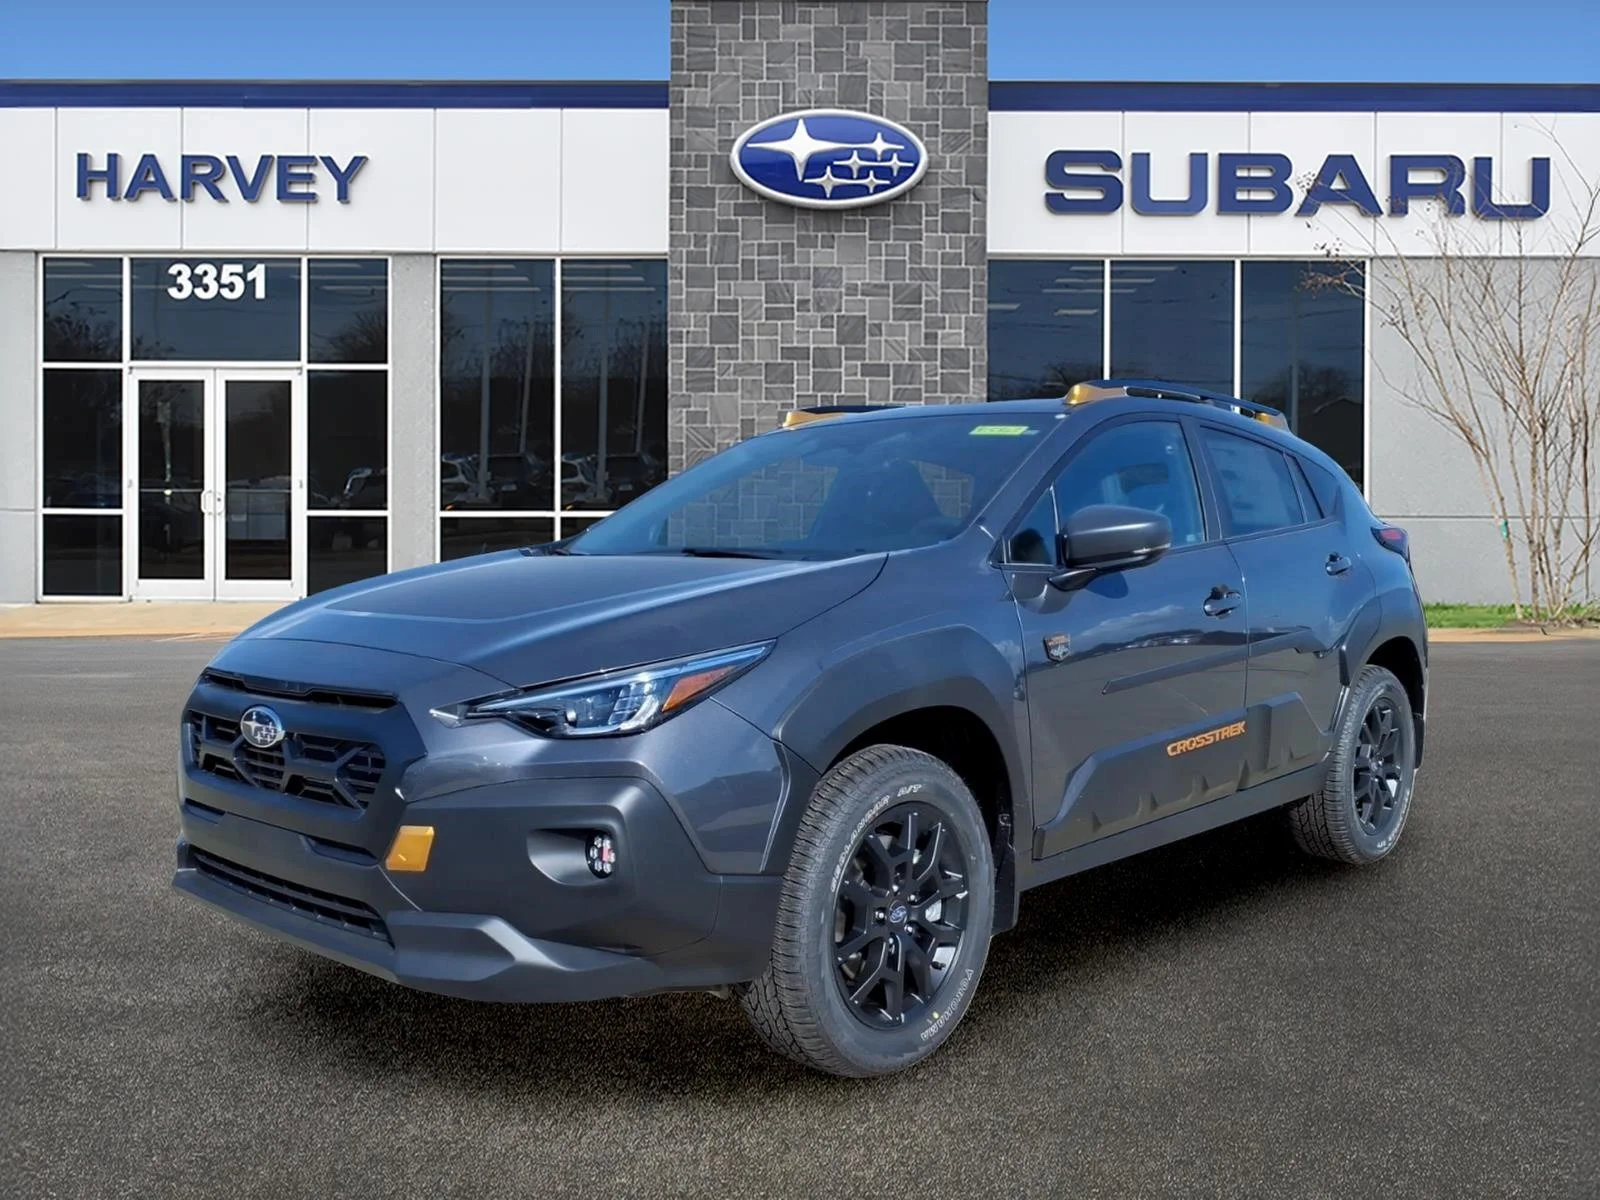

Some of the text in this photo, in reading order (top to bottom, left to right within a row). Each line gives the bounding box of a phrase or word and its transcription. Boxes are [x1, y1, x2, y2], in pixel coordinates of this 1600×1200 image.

[76, 152, 368, 204] HARVEY
[1045, 149, 1551, 219] SUBARU
[167, 262, 266, 300] 3351
[1166, 720, 1246, 757] CROSSTREK
[920, 968, 974, 1041] YOKOHAMA
